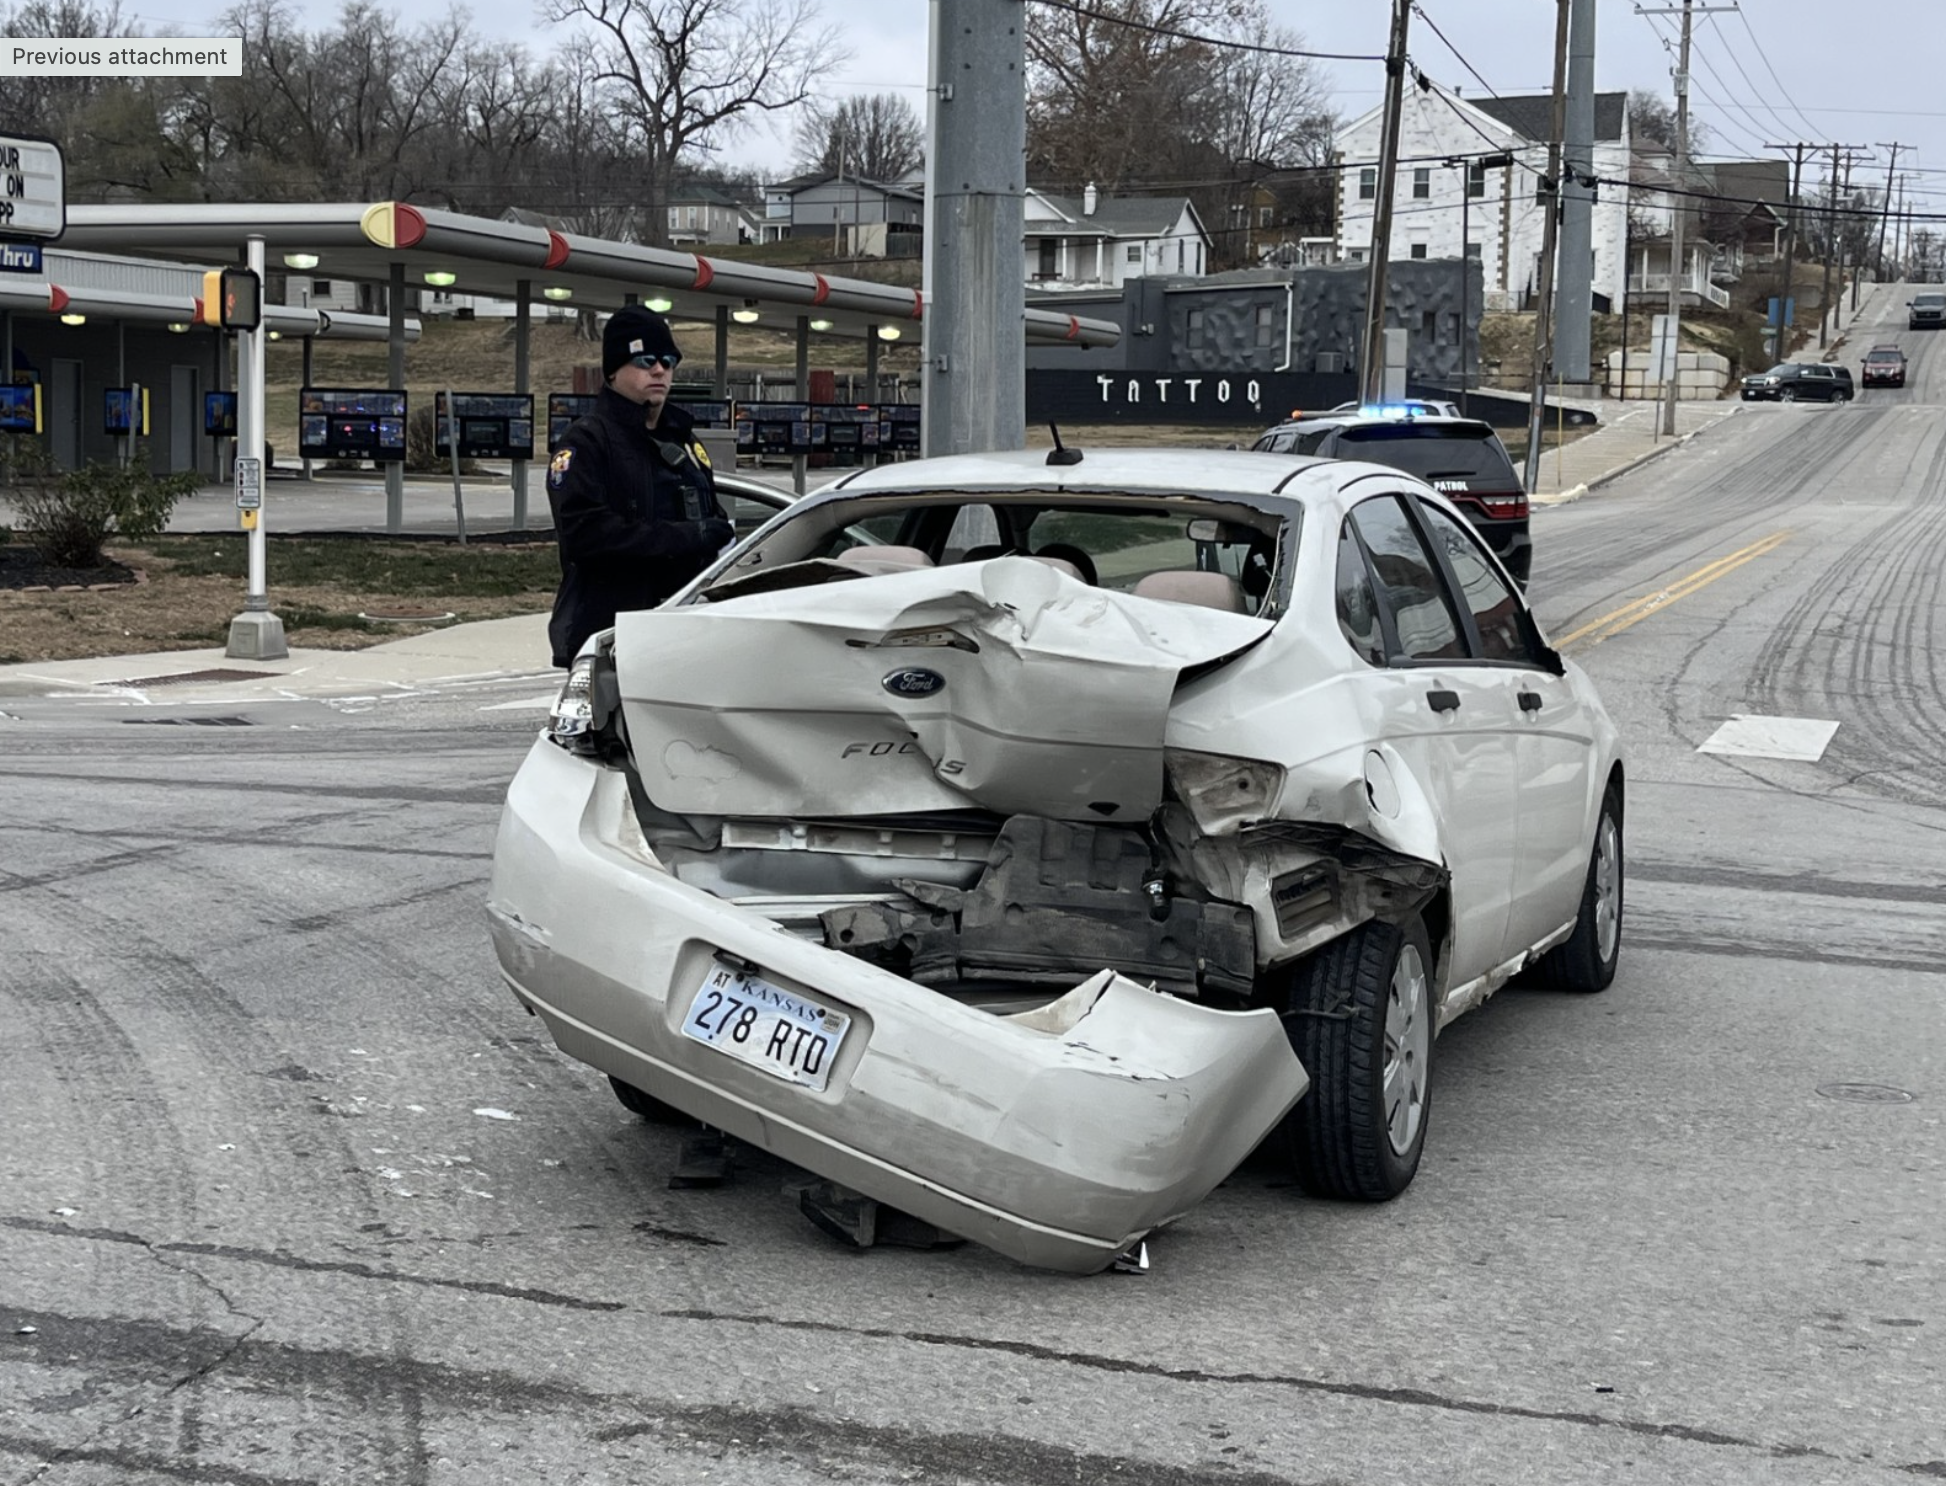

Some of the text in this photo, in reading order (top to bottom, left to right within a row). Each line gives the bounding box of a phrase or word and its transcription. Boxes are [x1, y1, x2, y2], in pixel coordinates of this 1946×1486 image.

[7, 174, 24, 199] ON
[1097, 375, 1260, 403] TATTOO
[1433, 480, 1469, 491] PATROL
[900, 672, 933, 691] Ford
[712, 971, 732, 989] AT
[742, 980, 818, 1022] KANSAS
[694, 991, 759, 1044] 278
